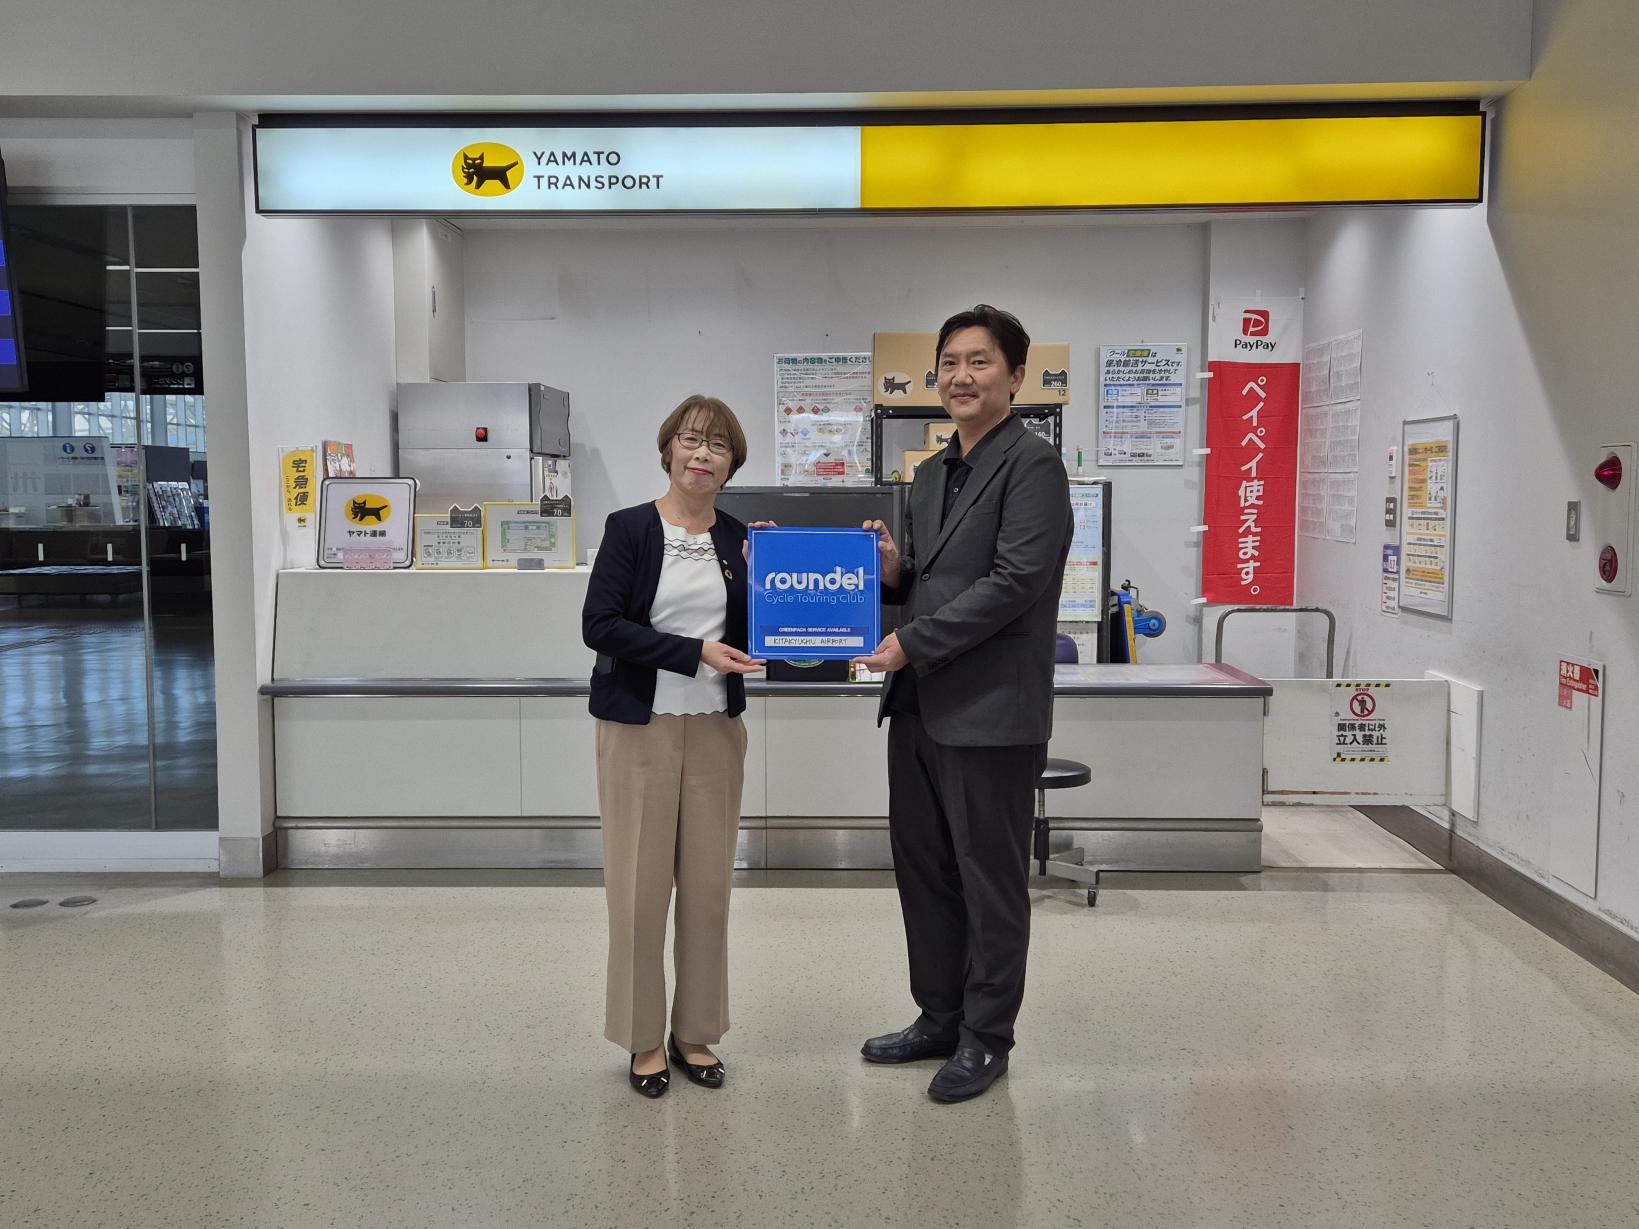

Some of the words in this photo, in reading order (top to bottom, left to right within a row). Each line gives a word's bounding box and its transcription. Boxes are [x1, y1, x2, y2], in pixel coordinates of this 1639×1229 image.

[533, 151, 621, 166] YAMATO
[533, 174, 664, 190] TRANSPORT
[1234, 338, 1277, 352] PayPay
[291, 457, 310, 507] 宅急便
[1236, 375, 1267, 596] ペイペイ使えます。
[553, 509, 562, 517] 70
[463, 520, 473, 528] 70
[346, 529, 388, 538] ヤマト運輸
[764, 565, 865, 591] roundel
[764, 592, 794, 605] Cycle
[797, 593, 838, 605] Touring
[839, 592, 865, 603] Club
[820, 638, 848, 646] AIRPORT
[1337, 722, 1387, 733] 関係者以外
[1336, 734, 1388, 746] 立入禁止
